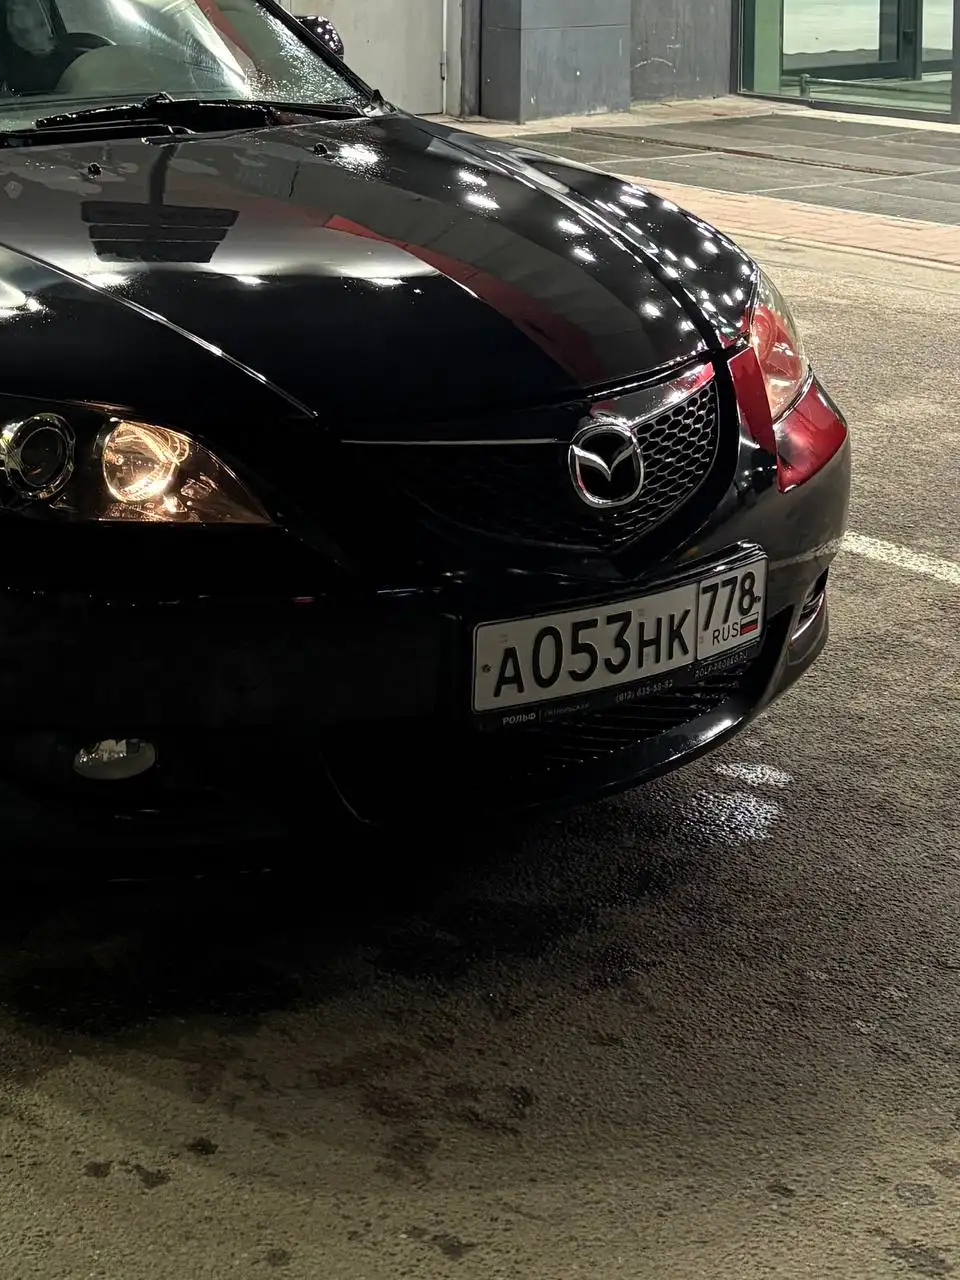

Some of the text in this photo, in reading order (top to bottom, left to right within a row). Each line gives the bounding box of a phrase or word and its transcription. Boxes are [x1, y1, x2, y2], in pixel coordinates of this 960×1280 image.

[493, 572, 755, 697] А053НК 778
[712, 622, 740, 646] RUS
[502, 712, 536, 726] РОЛЬФ
